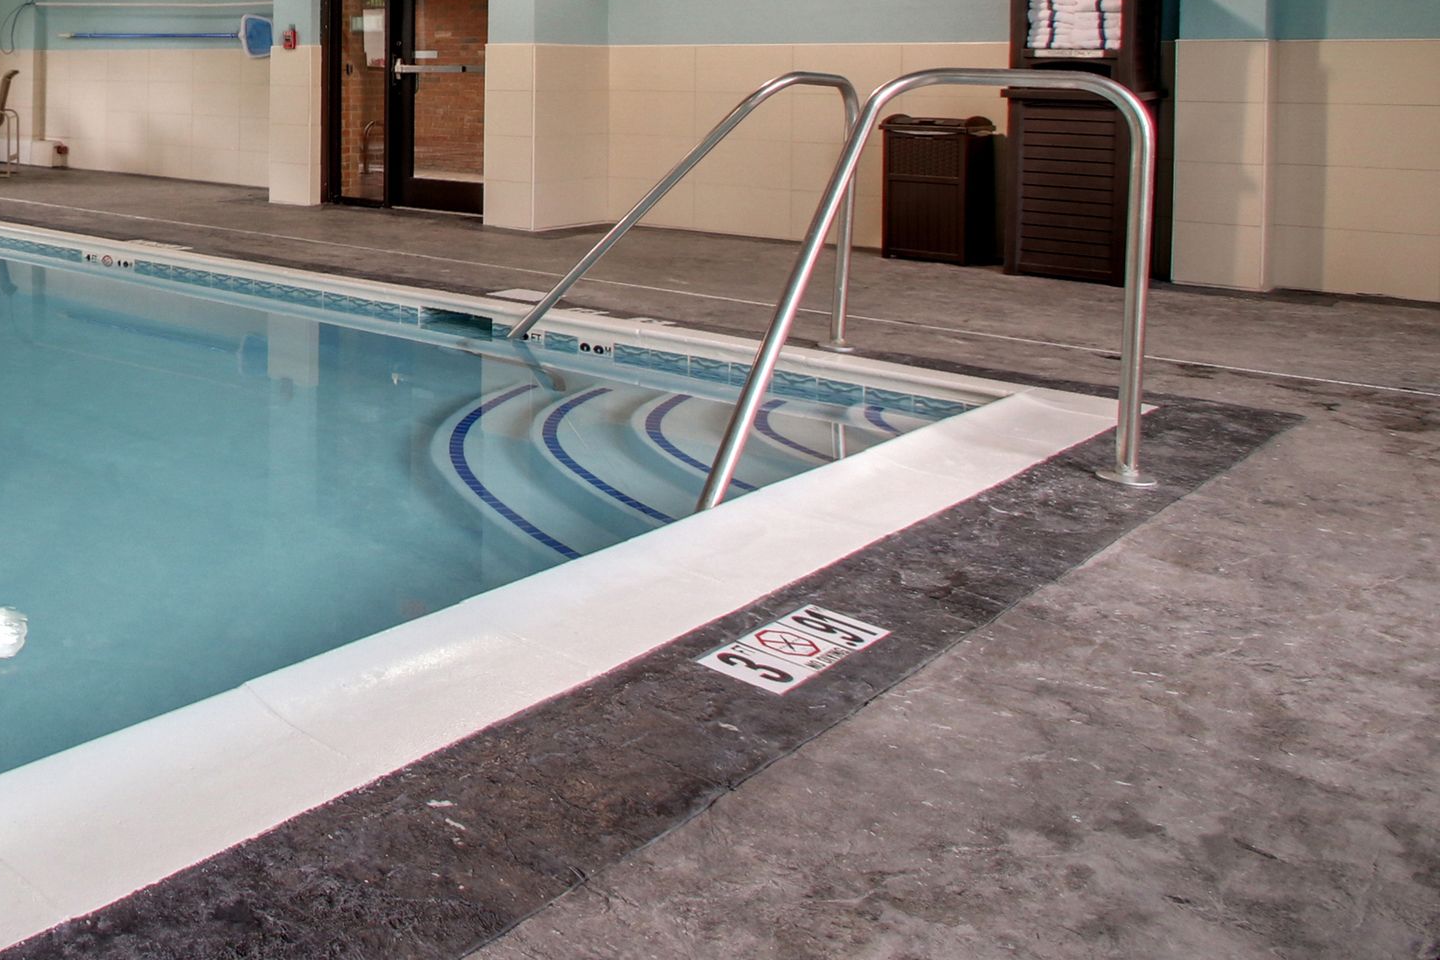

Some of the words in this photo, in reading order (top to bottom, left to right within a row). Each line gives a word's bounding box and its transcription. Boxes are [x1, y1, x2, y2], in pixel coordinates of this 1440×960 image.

[791, 609, 878, 647] .91
[717, 652, 794, 683] 3
[805, 660, 827, 671] NO
[816, 647, 851, 664] DIVING
